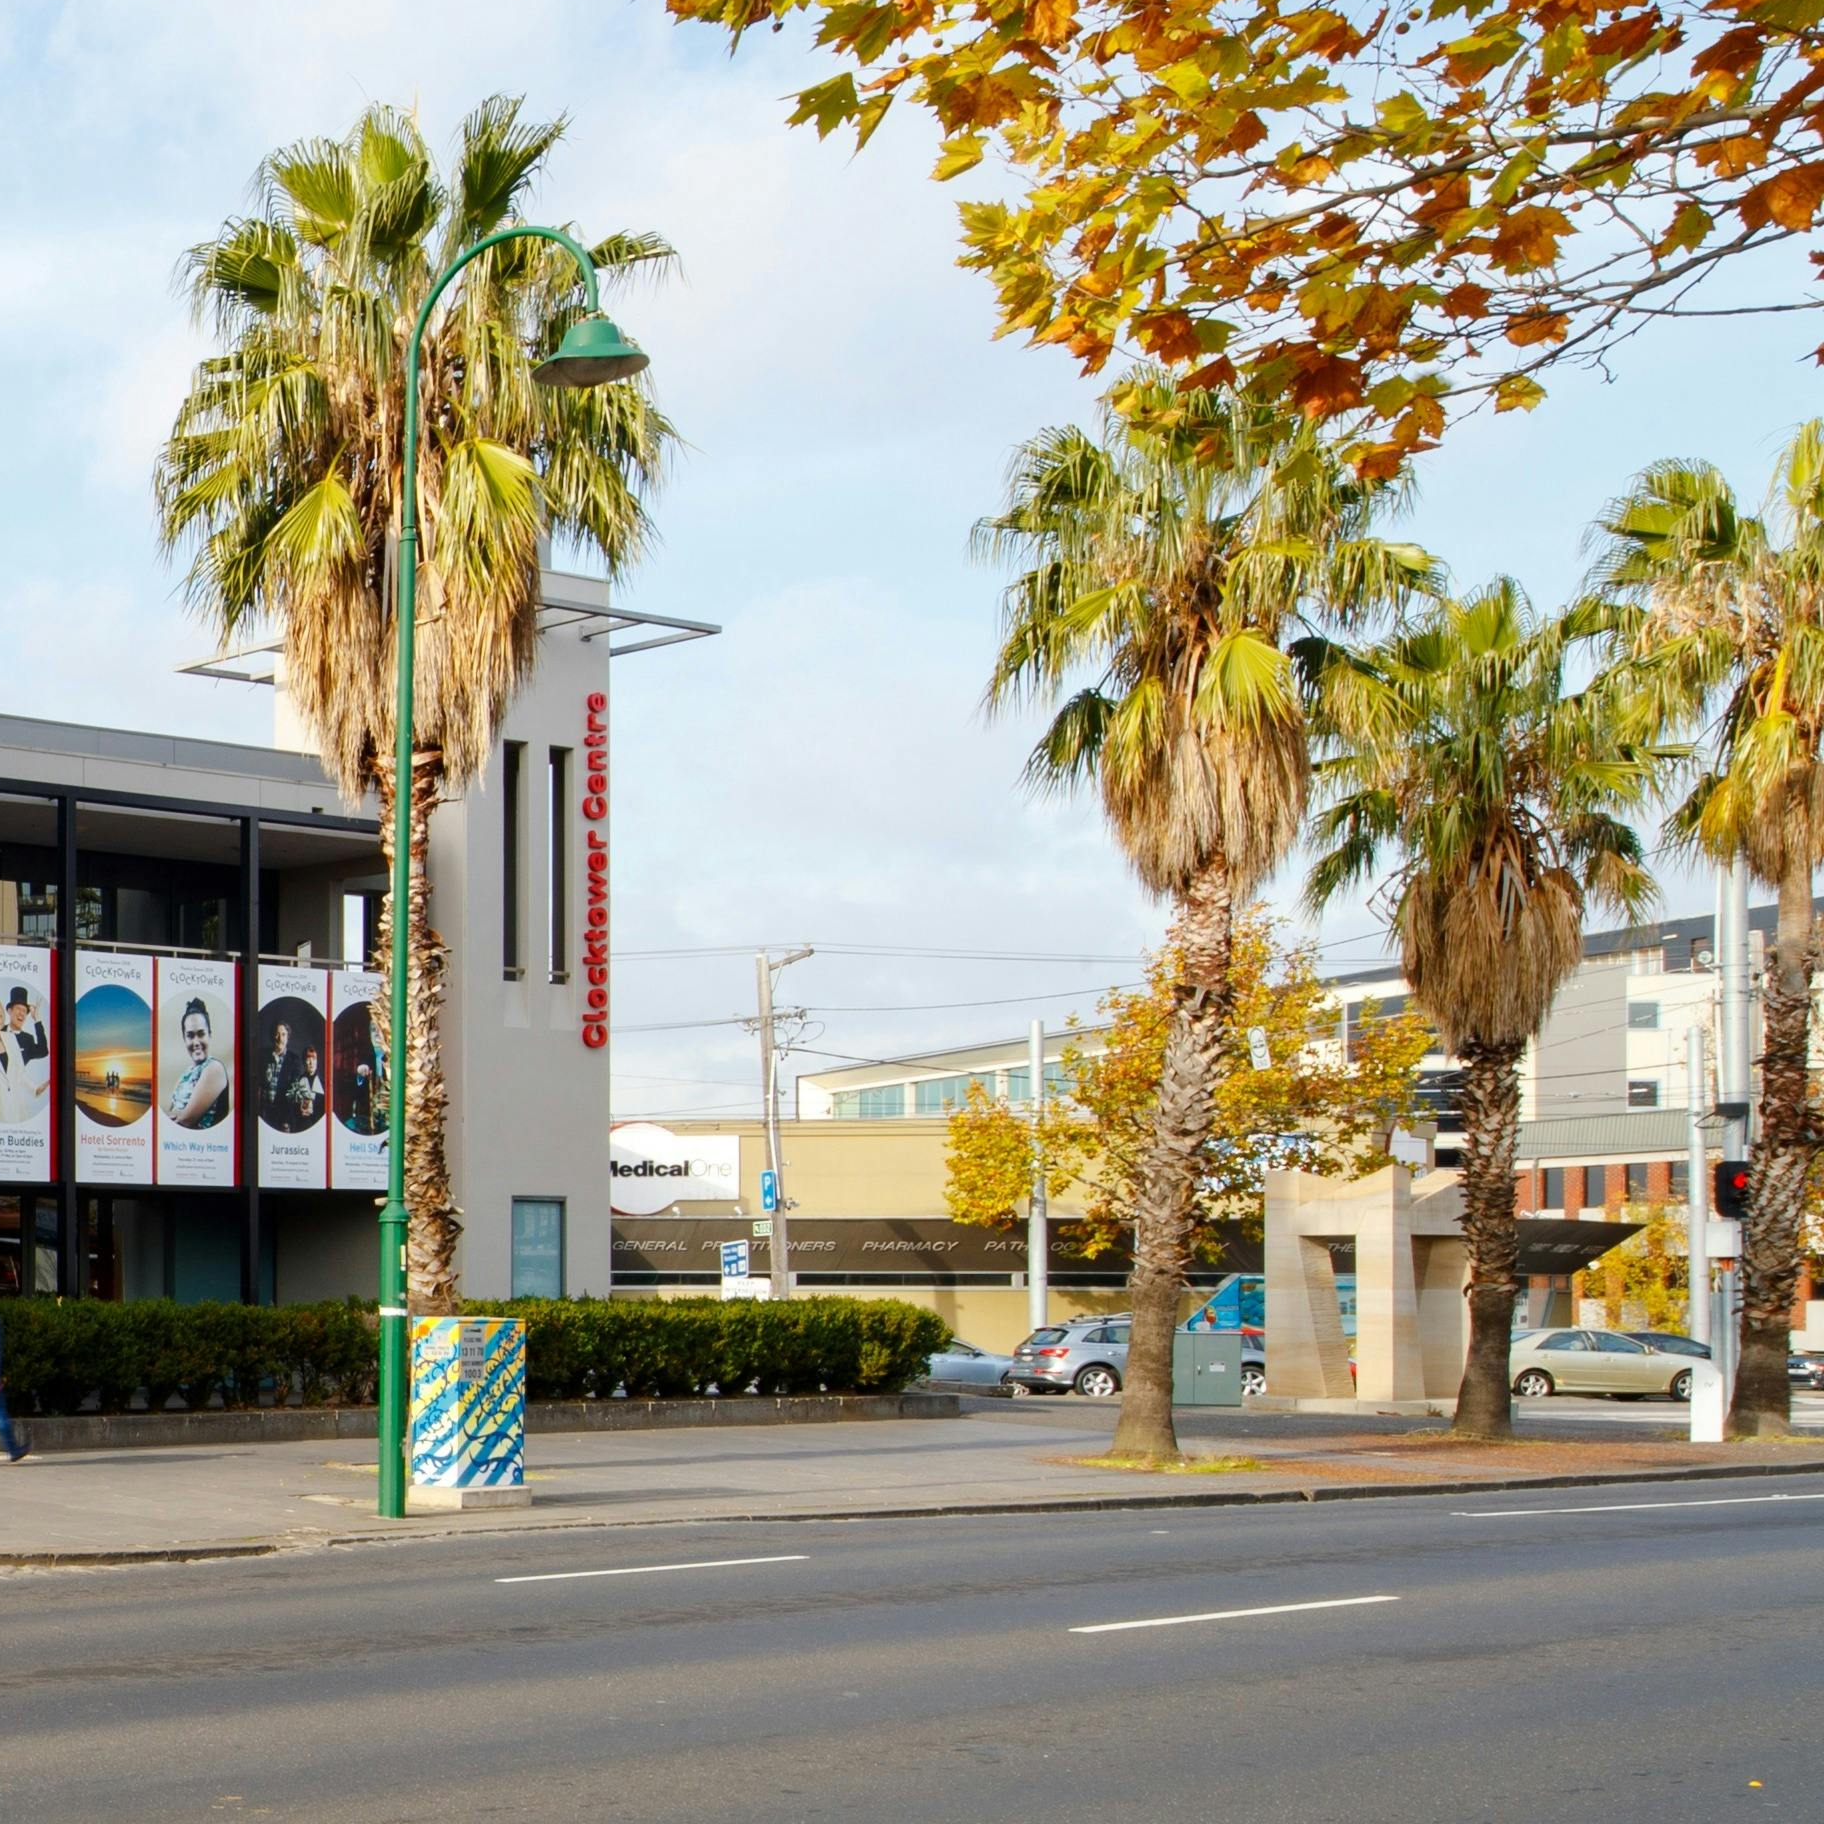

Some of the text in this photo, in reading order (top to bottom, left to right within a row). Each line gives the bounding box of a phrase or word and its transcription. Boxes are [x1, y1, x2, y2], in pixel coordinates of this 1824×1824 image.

[583, 692, 608, 1049] Clocktower Centre
[85, 965, 142, 980] CLOCKTOWER
[169, 971, 225, 987] CLOCKTOWER
[264, 978, 317, 993] CLOCKTOWER
[7, 1136, 45, 1147] Buddies
[80, 1133, 146, 1147] Hotel Sorrento
[163, 1141, 228, 1154] Which Way Home
[270, 1144, 309, 1156] Jurassica
[764, 1175, 771, 1191] P
[612, 1240, 689, 1252] GENERAL
[861, 1240, 960, 1252] PHARMACY
